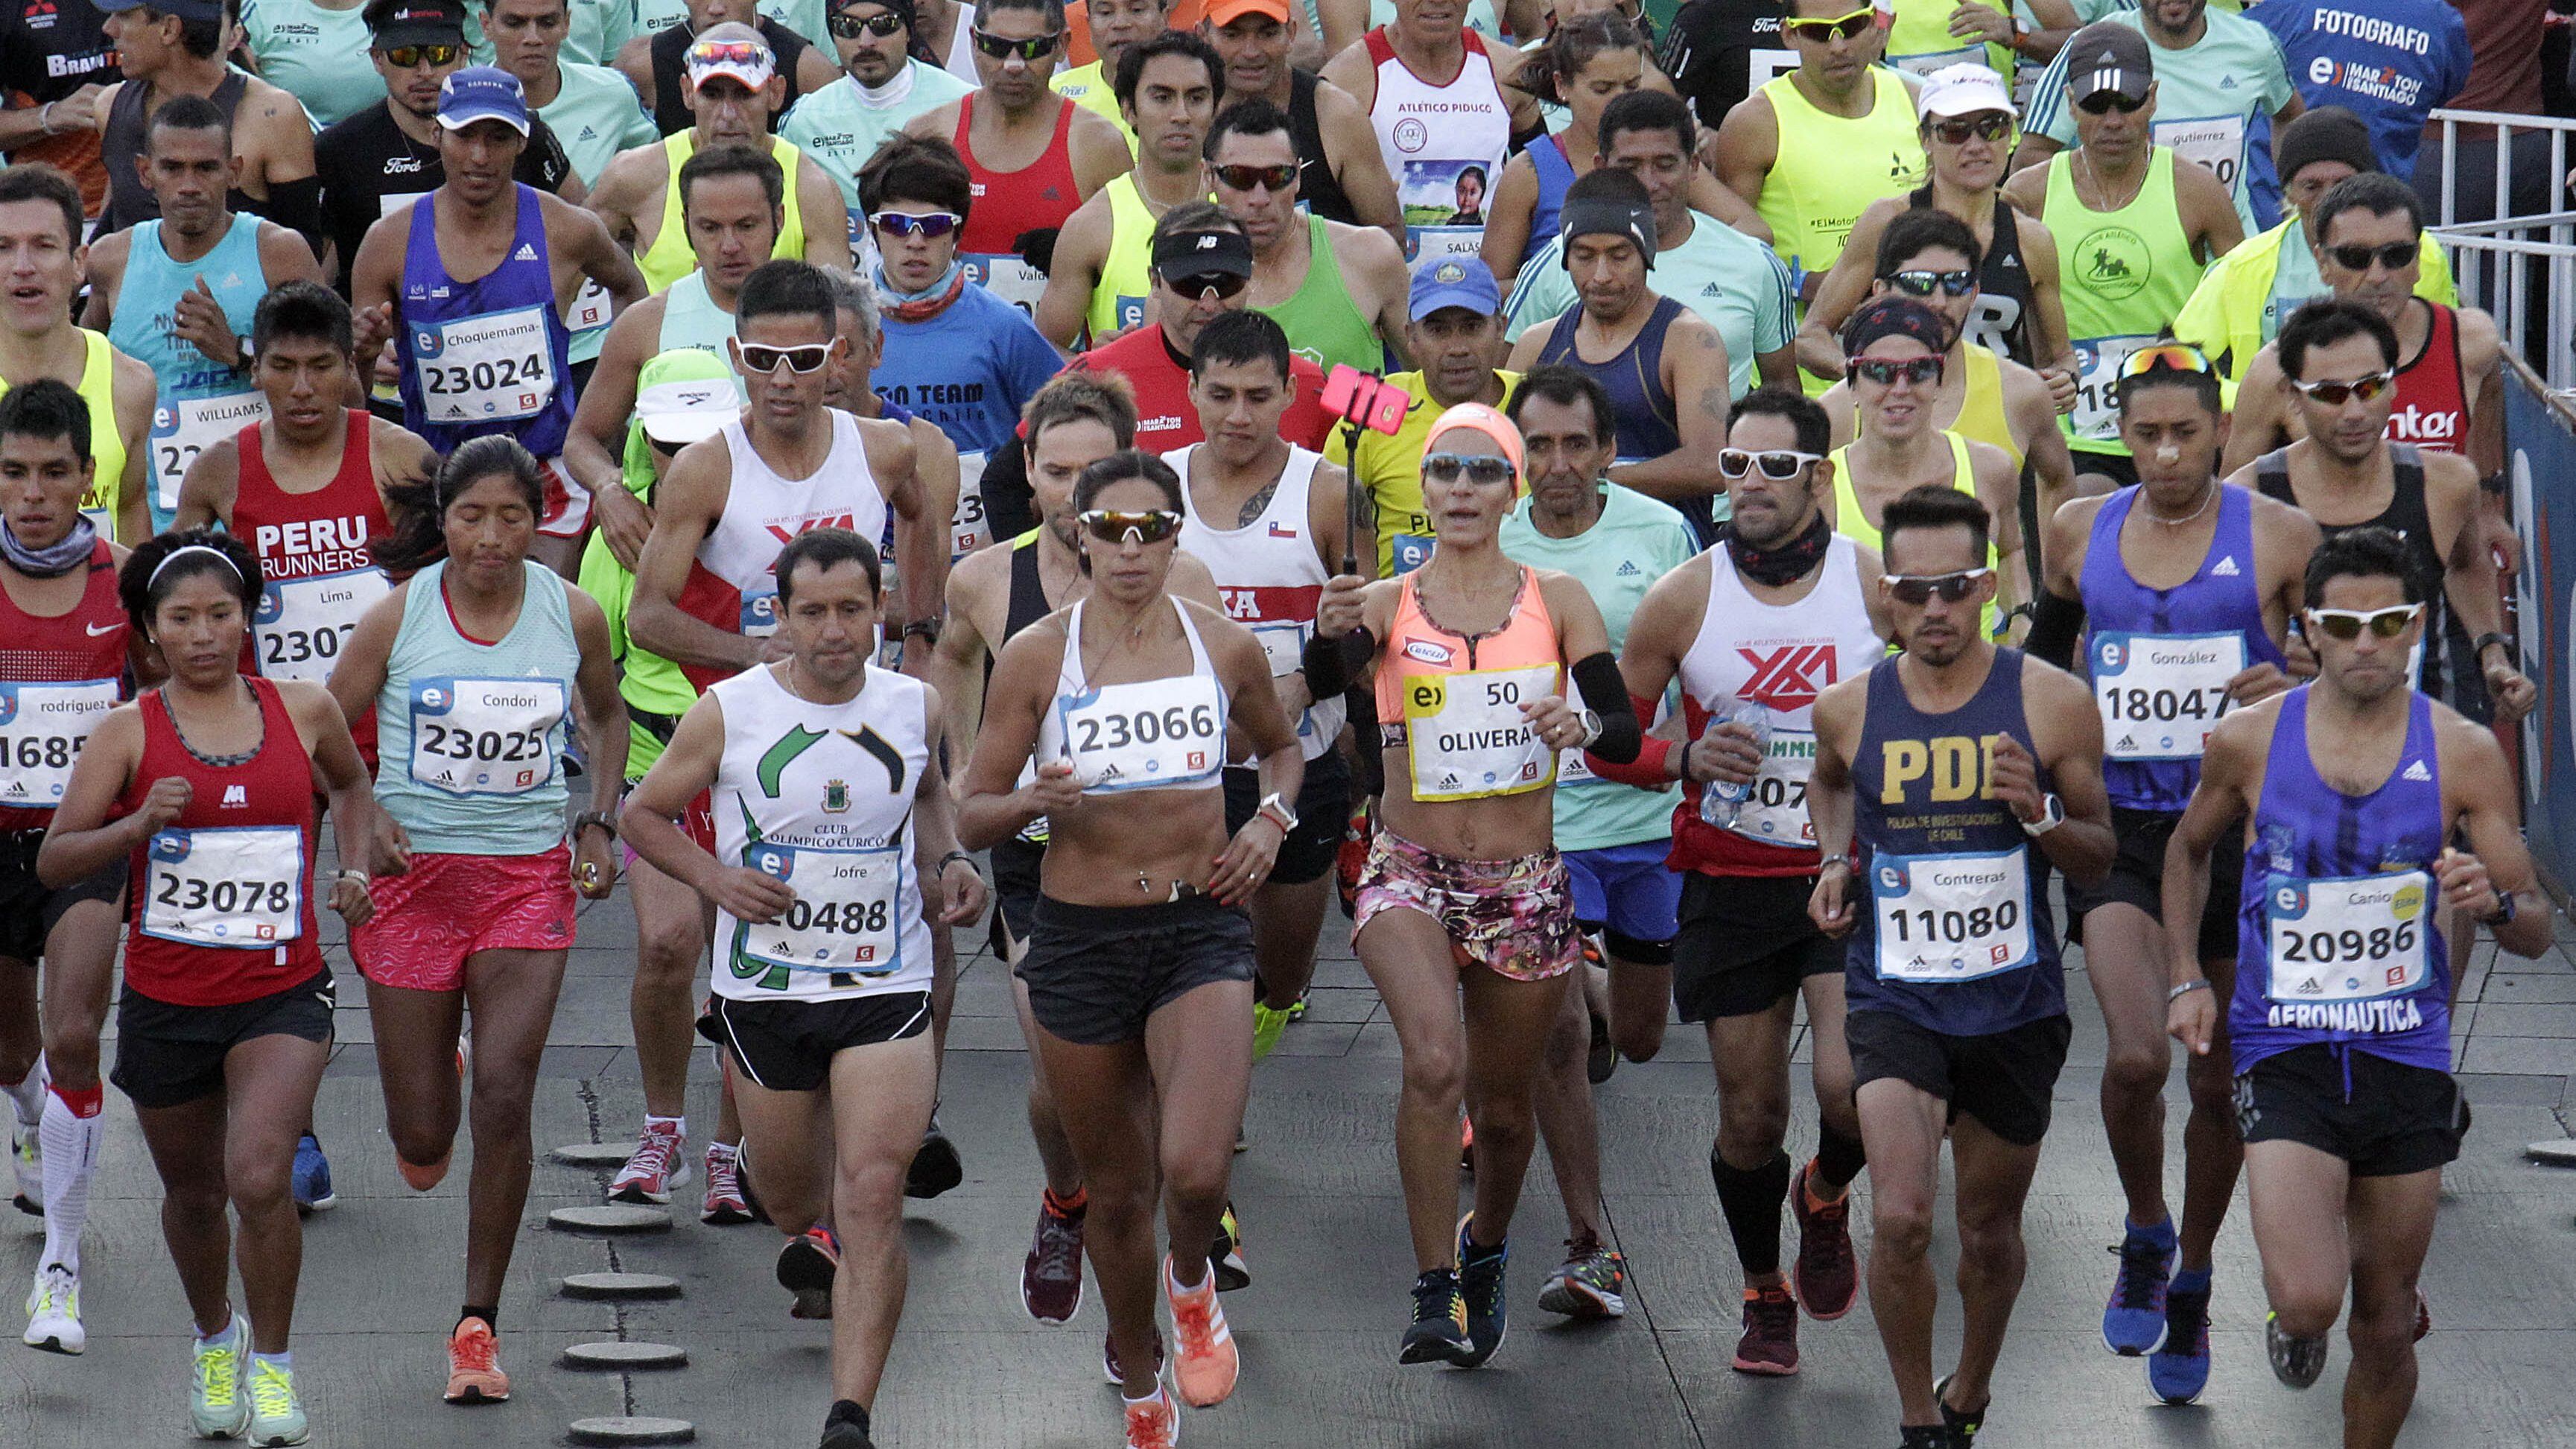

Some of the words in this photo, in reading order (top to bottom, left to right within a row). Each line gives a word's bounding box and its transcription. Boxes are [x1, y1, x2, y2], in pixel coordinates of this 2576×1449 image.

[2313, 7, 2429, 55] FOTOGRAFO
[1398, 101, 1448, 112] ATLÉTICO
[2174, 132, 2224, 145] gutierrez
[384, 156, 421, 174] Ford
[1447, 242, 1480, 253] SALAS
[448, 322, 540, 348] Choquemama-
[426, 353, 544, 395] 23024
[916, 382, 983, 404] TEAM
[196, 402, 264, 422] WILLIAMS
[256, 515, 369, 557] PERU
[261, 548, 369, 579] RUNNERS
[320, 591, 353, 603] Lima
[2151, 650, 2217, 665] González
[482, 694, 537, 708] Condori
[1487, 682, 1519, 706] 50
[2105, 687, 2232, 721] 18047
[41, 699, 106, 714] rodriguez
[1077, 704, 1214, 753] 23066
[423, 723, 543, 763] 23025
[1439, 729, 1532, 753] OLIVERA
[815, 825, 848, 834] CLUB
[831, 864, 867, 879] Jofre
[1934, 870, 2006, 887] Contreras
[157, 872, 289, 913] 23078
[768, 899, 886, 933] 0488
[1889, 899, 2018, 943] 11080
[2282, 919, 2415, 963] 20986
